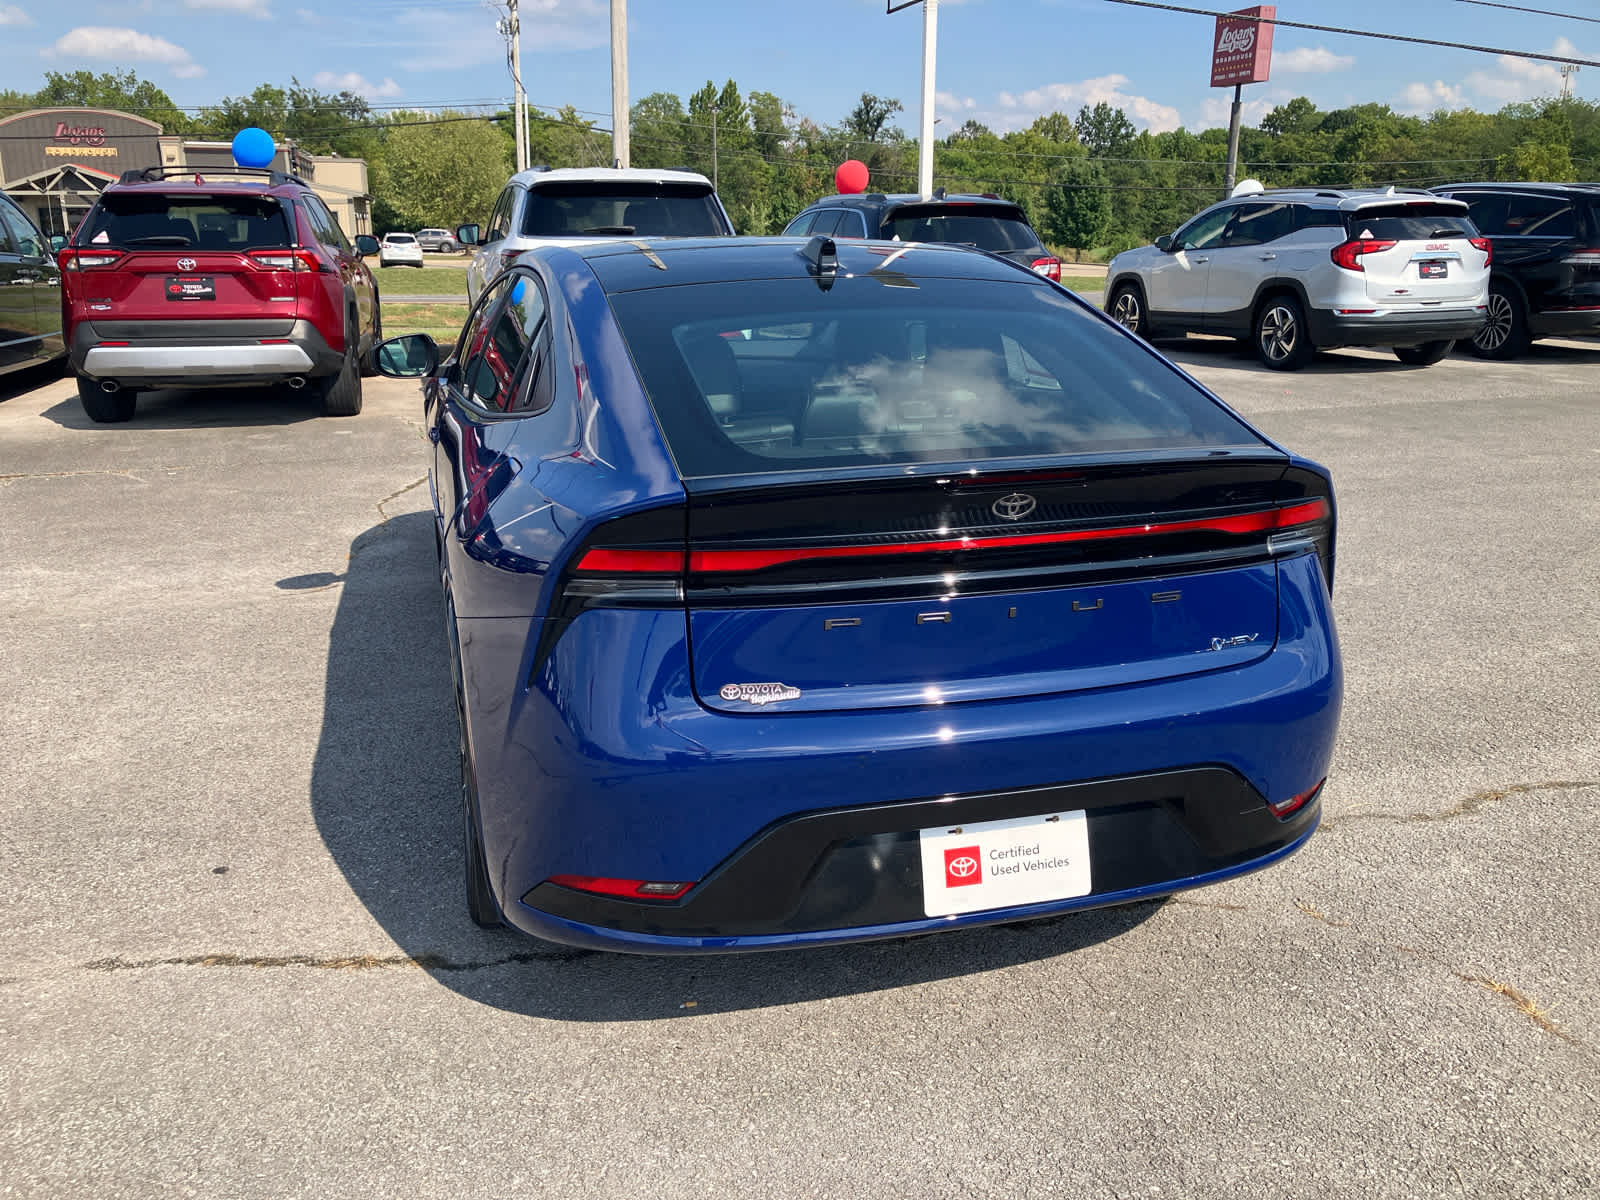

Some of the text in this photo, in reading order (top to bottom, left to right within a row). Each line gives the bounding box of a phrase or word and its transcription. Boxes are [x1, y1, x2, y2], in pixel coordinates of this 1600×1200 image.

[824, 590, 1182, 631] PRIUS
[741, 685, 782, 694] TOYOTA
[989, 844, 1040, 860] Certified
[990, 857, 1070, 876] Used Vehicles
